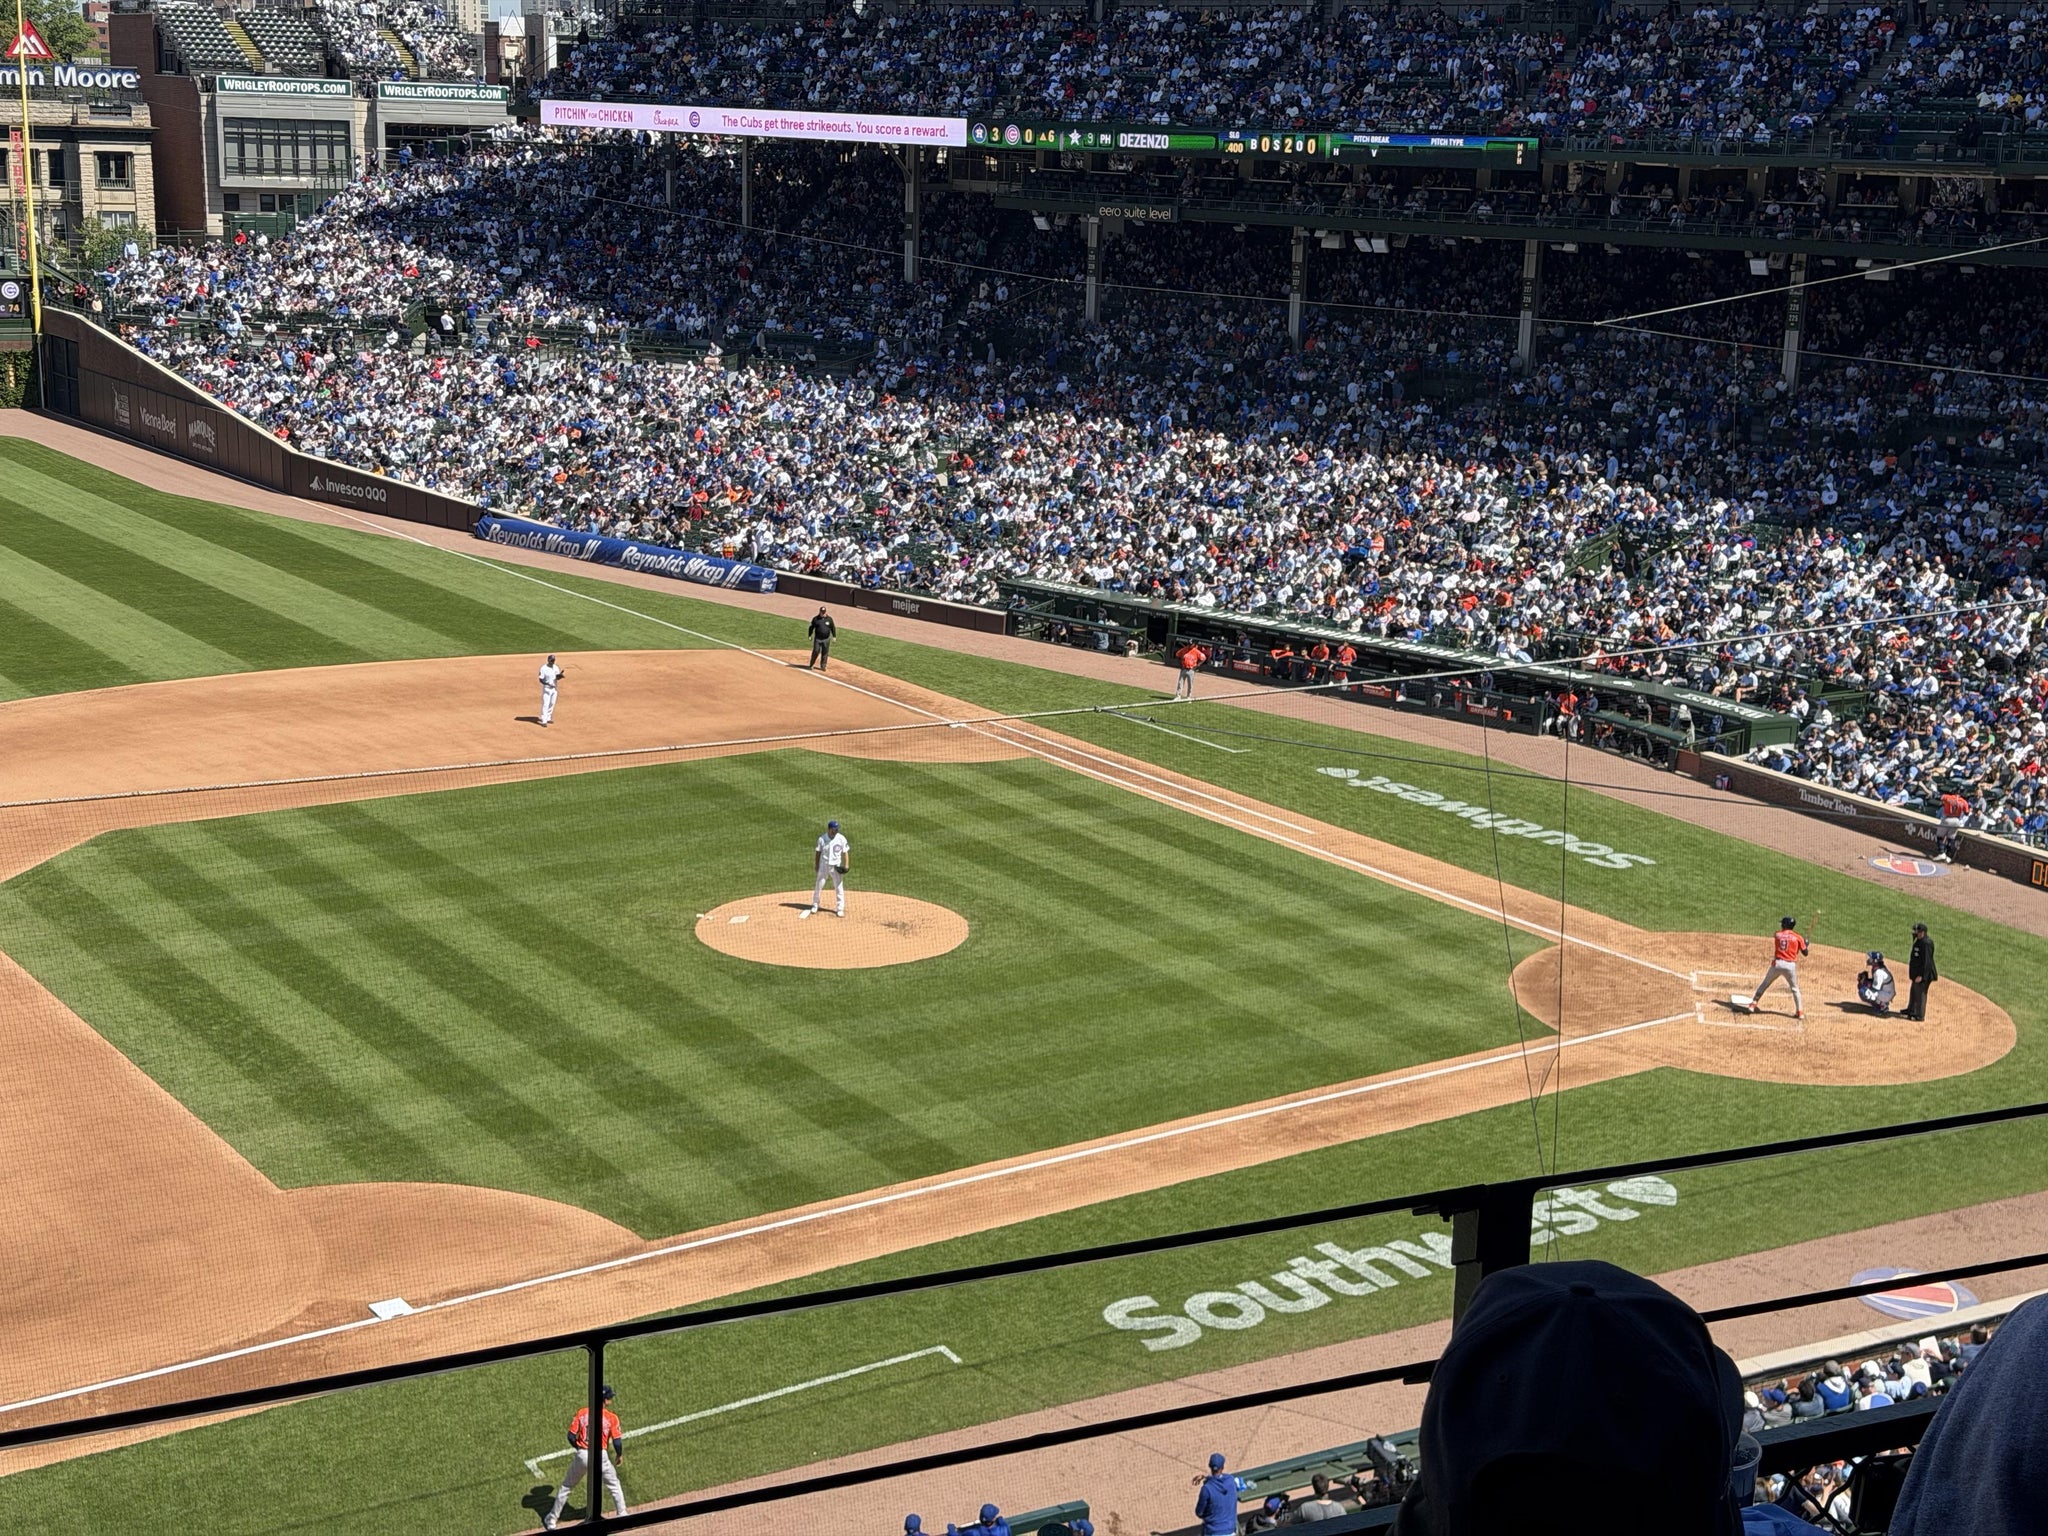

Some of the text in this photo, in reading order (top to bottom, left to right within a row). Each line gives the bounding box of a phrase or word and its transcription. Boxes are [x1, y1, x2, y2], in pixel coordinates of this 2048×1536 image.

[54, 65, 138, 89] Moore
[224, 79, 346, 94] WRIGLEYROOFTOPS.COM
[384, 85, 502, 99] WRIGLEYROOFTOPS.COM
[598, 109, 633, 123] CHICKEN
[722, 115, 949, 138] The Cubs get three strikeouts. You score a reward.
[991, 127, 999, 142] 3
[1024, 128, 1032, 143] 0
[1048, 129, 1055, 143] 6
[1099, 133, 1111, 145] PH
[1119, 133, 1169, 149] DEZENZO
[1229, 131, 1240, 139] SLG
[1353, 135, 1390, 144] PITCH BREAK
[1430, 137, 1464, 147] PITCH TYPE
[1225, 142, 1244, 153] .400
[1250, 138, 1258, 150] B
[1261, 137, 1270, 153] 0
[1273, 139, 1281, 151] S
[1284, 138, 1292, 154] 2
[1307, 138, 1316, 154] 0
[1333, 148, 1339, 156] H
[1371, 149, 1377, 158] V
[1099, 205, 1172, 220] eero suite level
[8, 304, 20, 313] 74
[139, 406, 162, 430] Vienna
[161, 413, 177, 439] Beef
[188, 419, 215, 447] MARQUEE
[325, 478, 387, 503] Invesco QQQ
[485, 523, 580, 558] Reynolds Wrap
[620, 545, 725, 584] Reynolds Wrap
[892, 598, 920, 615] meijer
[1798, 787, 1858, 816] TimberTech
[1347, 775, 1657, 869] Southwest
[1102, 1184, 1641, 1352] Southwst
